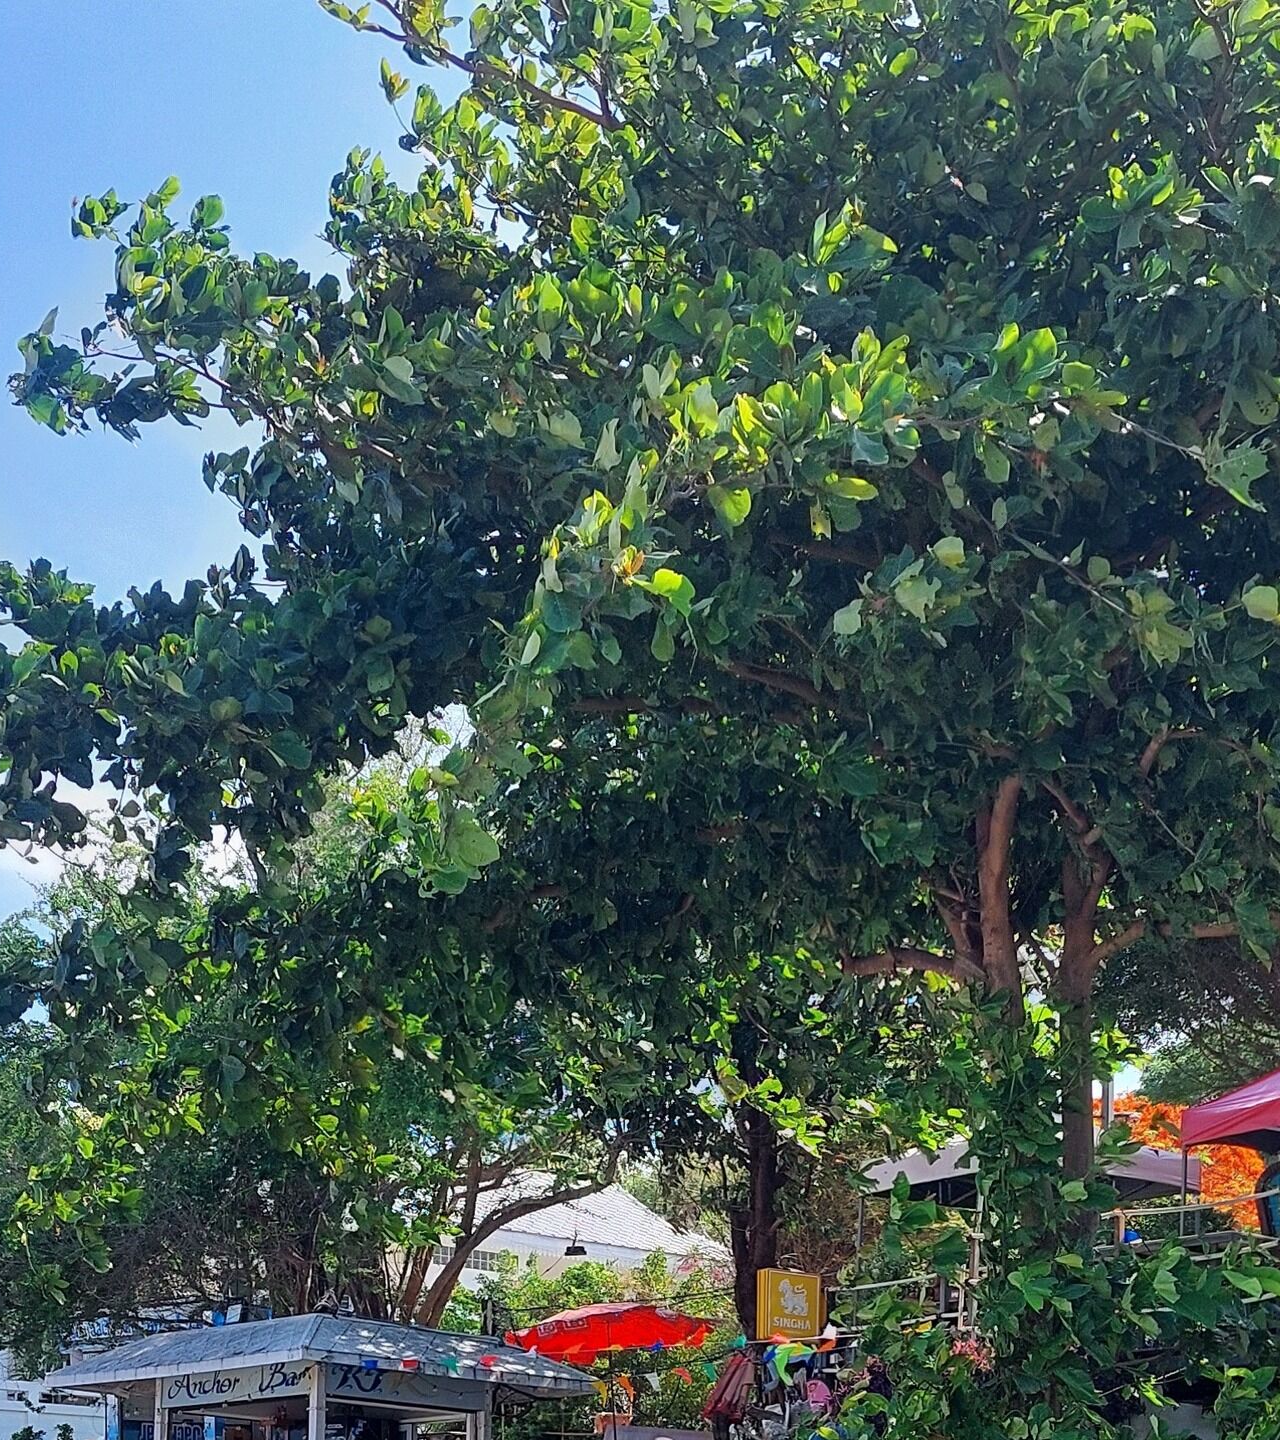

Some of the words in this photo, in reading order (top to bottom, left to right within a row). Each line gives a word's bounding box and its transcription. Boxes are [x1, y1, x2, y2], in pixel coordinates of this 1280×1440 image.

[773, 1316, 811, 1330] SINGHA
[168, 1370, 241, 1399] Anchor
[259, 1363, 308, 1394] Bar
